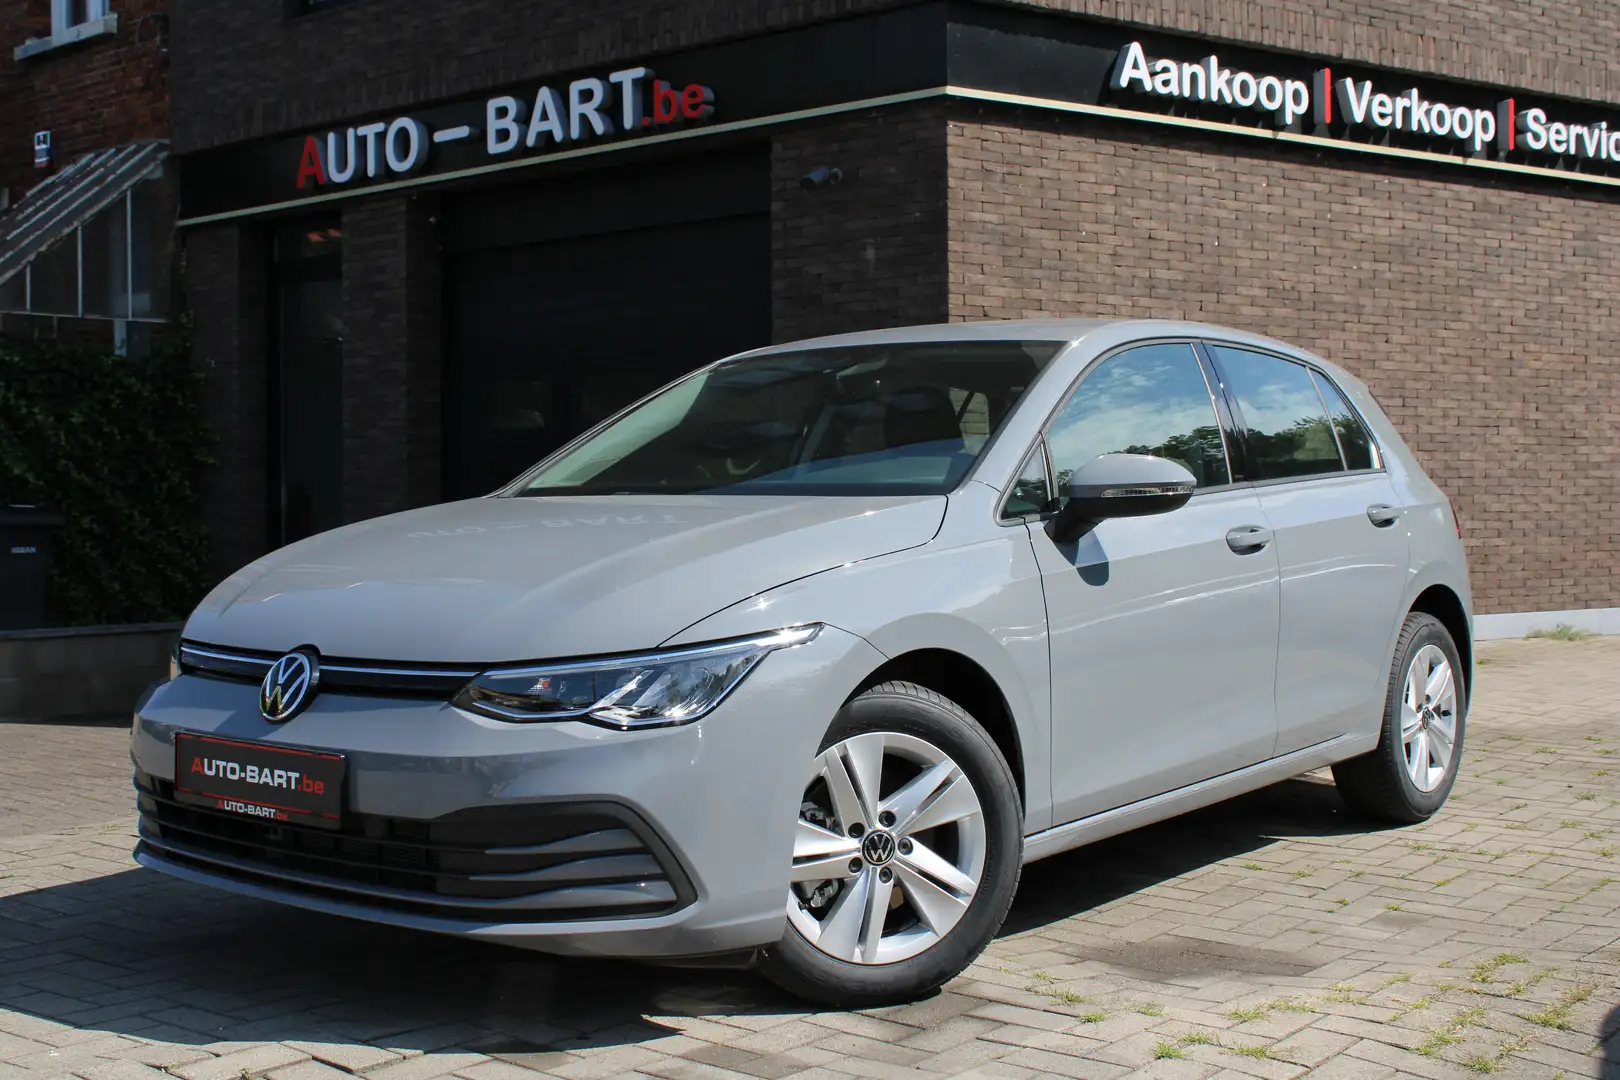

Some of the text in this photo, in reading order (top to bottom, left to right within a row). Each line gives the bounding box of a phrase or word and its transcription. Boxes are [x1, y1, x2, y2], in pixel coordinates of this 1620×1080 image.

[296, 116, 421, 189] AUTO
[485, 66, 708, 156] BART.be
[1118, 41, 1310, 125] Aankoop
[1344, 77, 1496, 151] Verkoop
[191, 757, 325, 795] AUTO-BART.be
